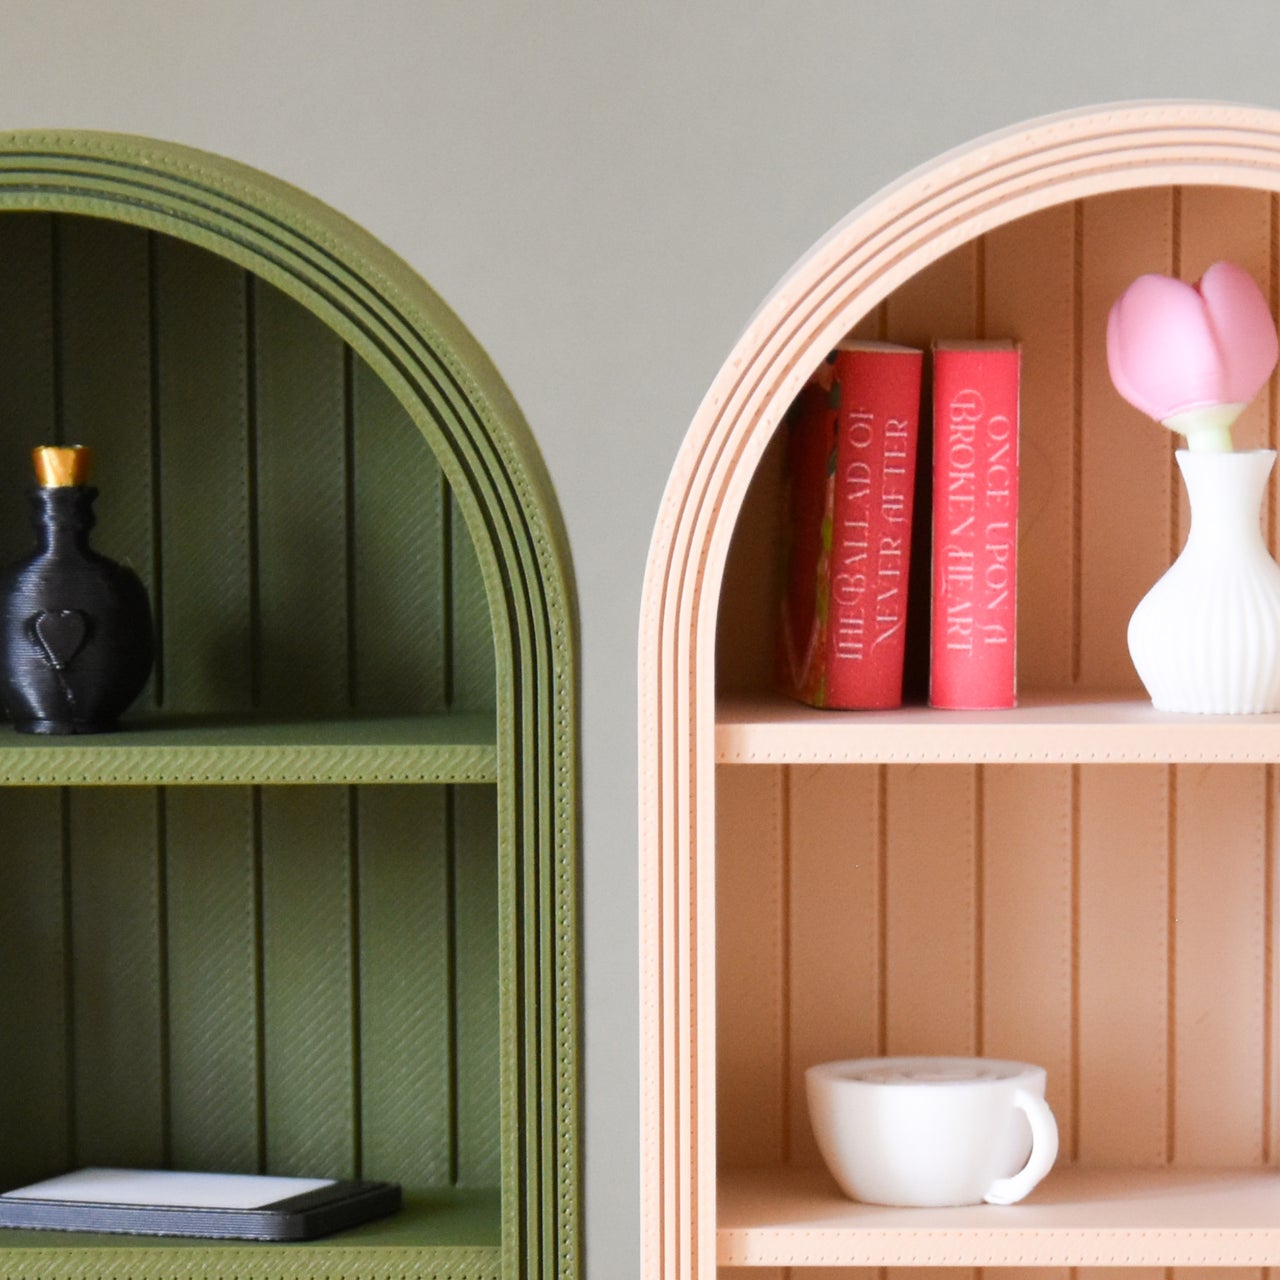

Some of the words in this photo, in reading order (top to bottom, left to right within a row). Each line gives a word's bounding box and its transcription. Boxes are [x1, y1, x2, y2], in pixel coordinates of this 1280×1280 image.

[848, 408, 873, 448] OF
[881, 418, 908, 524] AFTER
[948, 388, 984, 538] BROKEN
[986, 414, 1010, 508] ONCE
[835, 462, 871, 606] BALLAD
[984, 521, 1013, 610] UPON
[835, 607, 864, 660] THE
[871, 537, 902, 650] NEVER
[941, 542, 975, 657] HEART
[974, 623, 1008, 645] A
